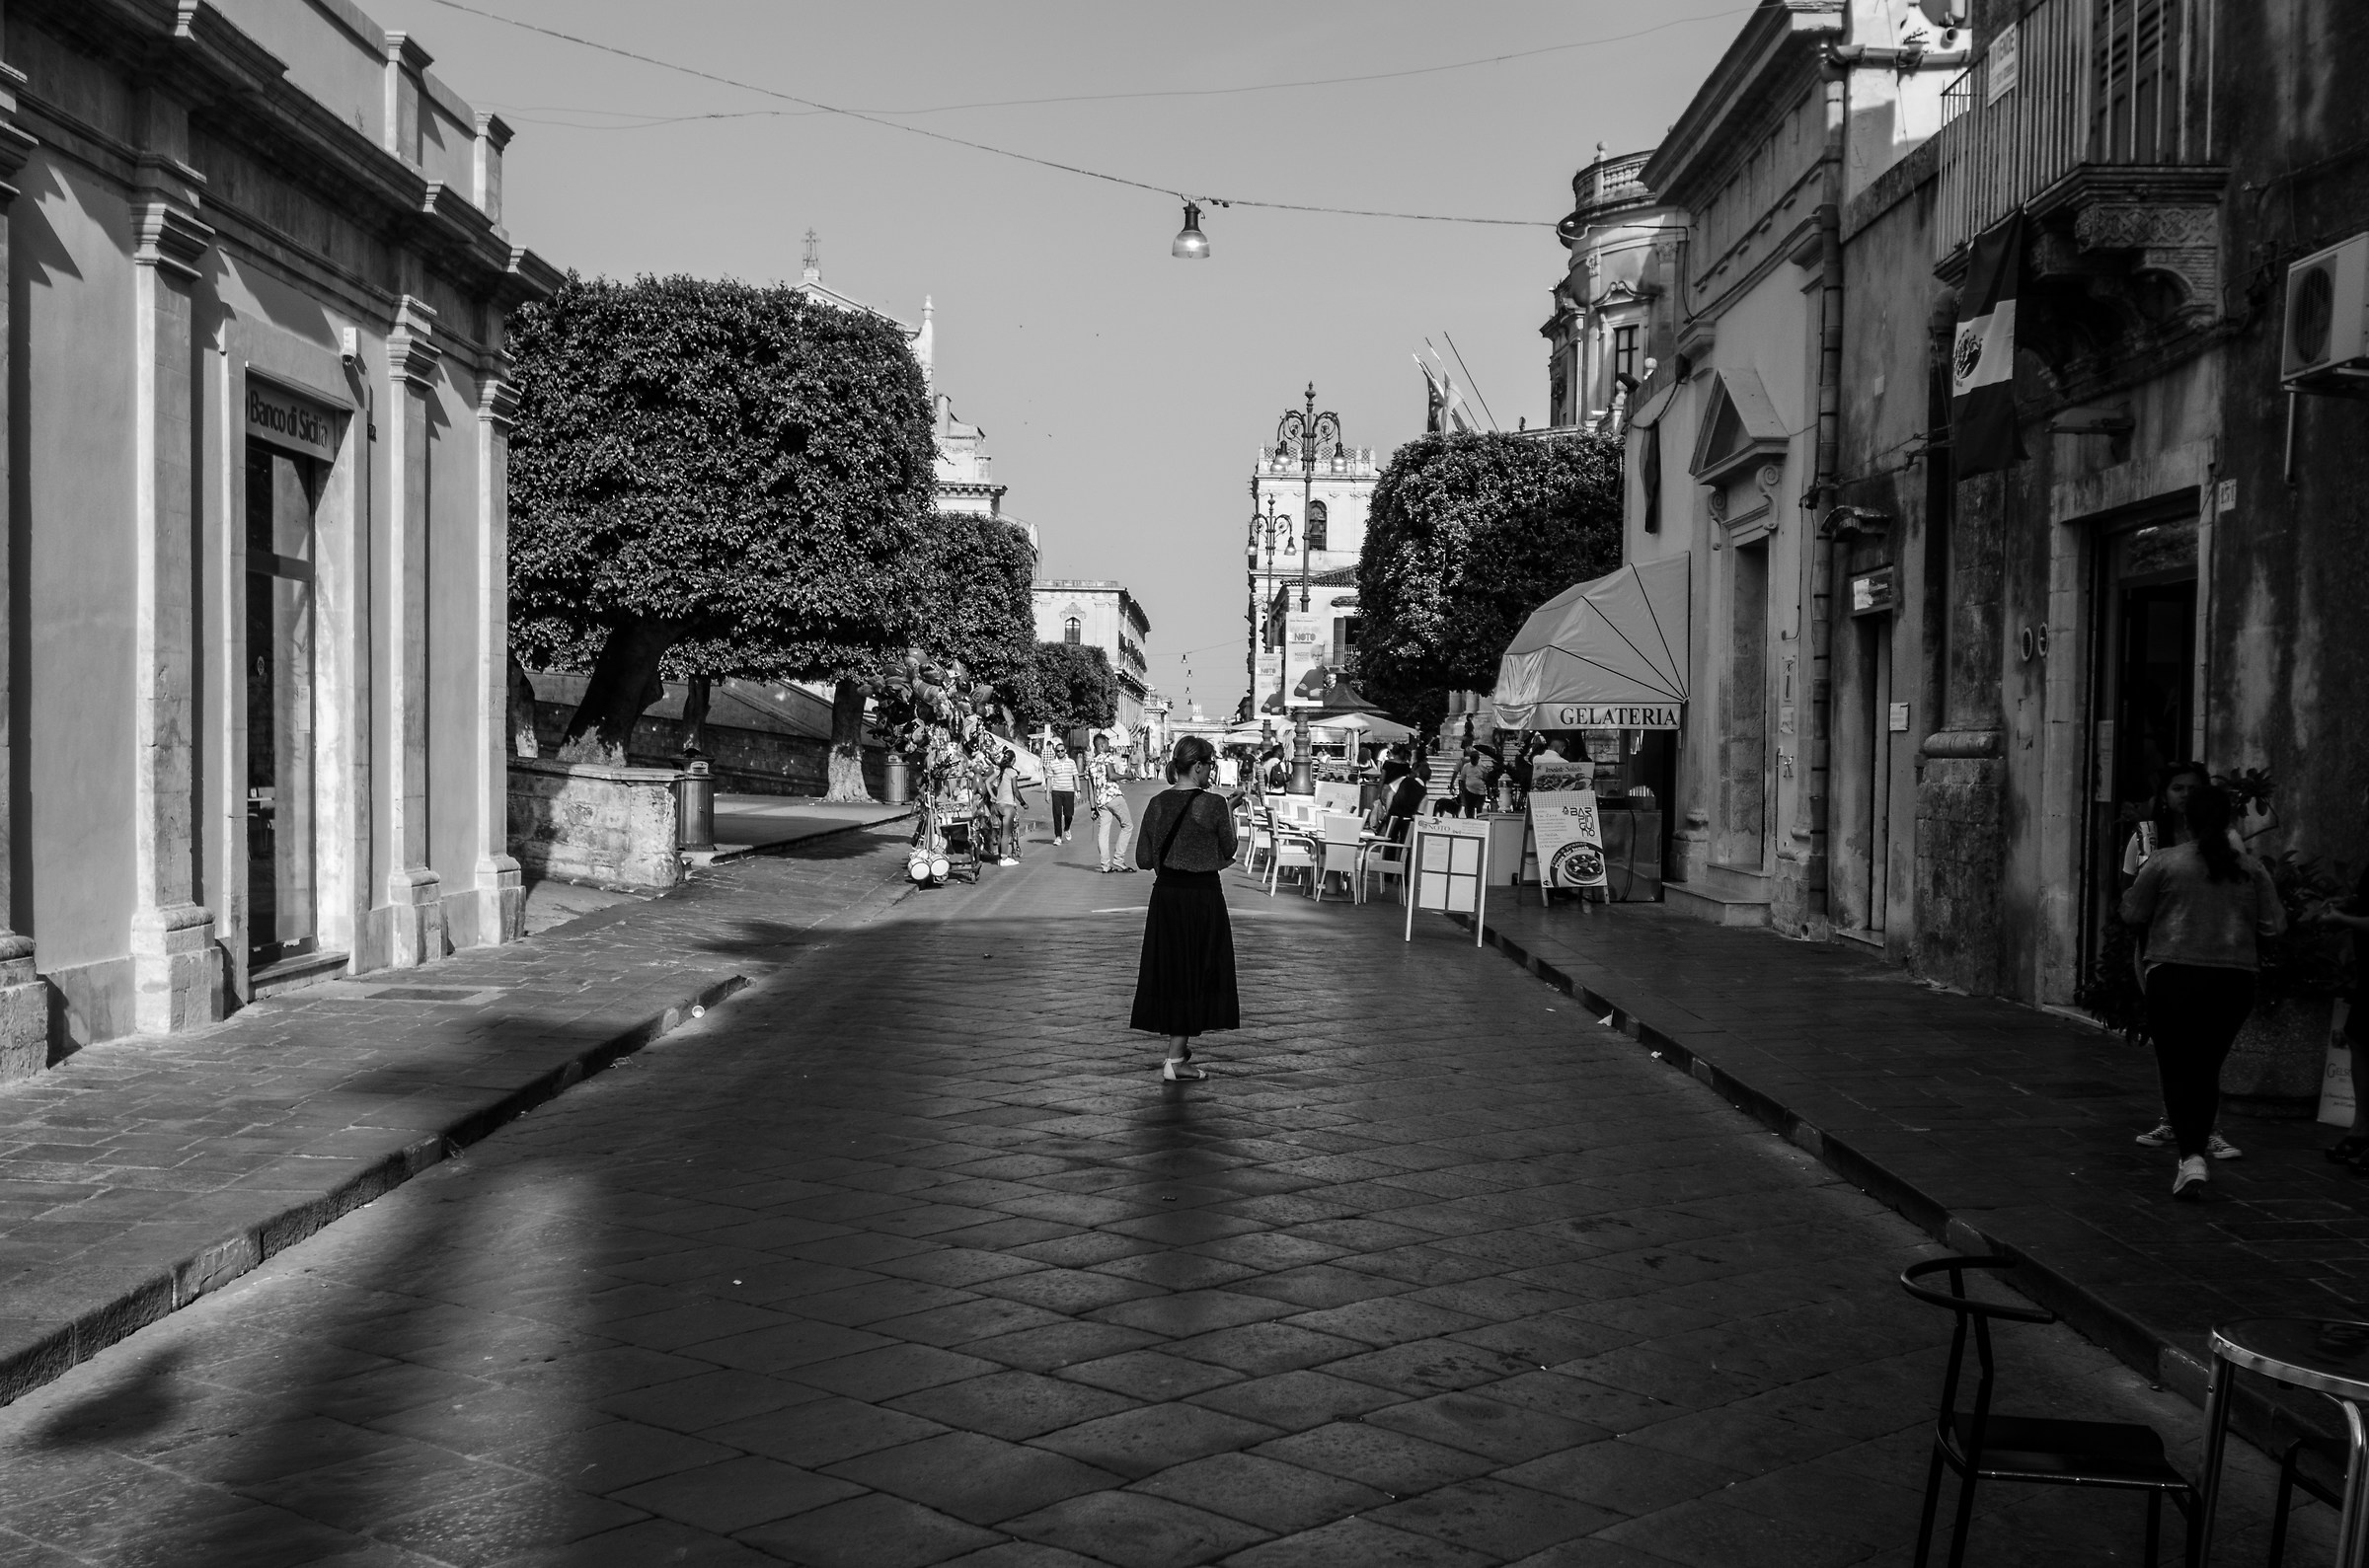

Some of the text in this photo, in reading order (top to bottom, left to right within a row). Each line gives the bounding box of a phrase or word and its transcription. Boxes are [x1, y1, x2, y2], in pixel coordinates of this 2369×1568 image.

[250, 390, 286, 433] Banco
[287, 406, 297, 437] di
[298, 409, 328, 448] Sicilia
[1294, 633, 1317, 641] NOTO
[1560, 708, 1678, 726] GELATERIA
[1569, 807, 1592, 816] BAR
